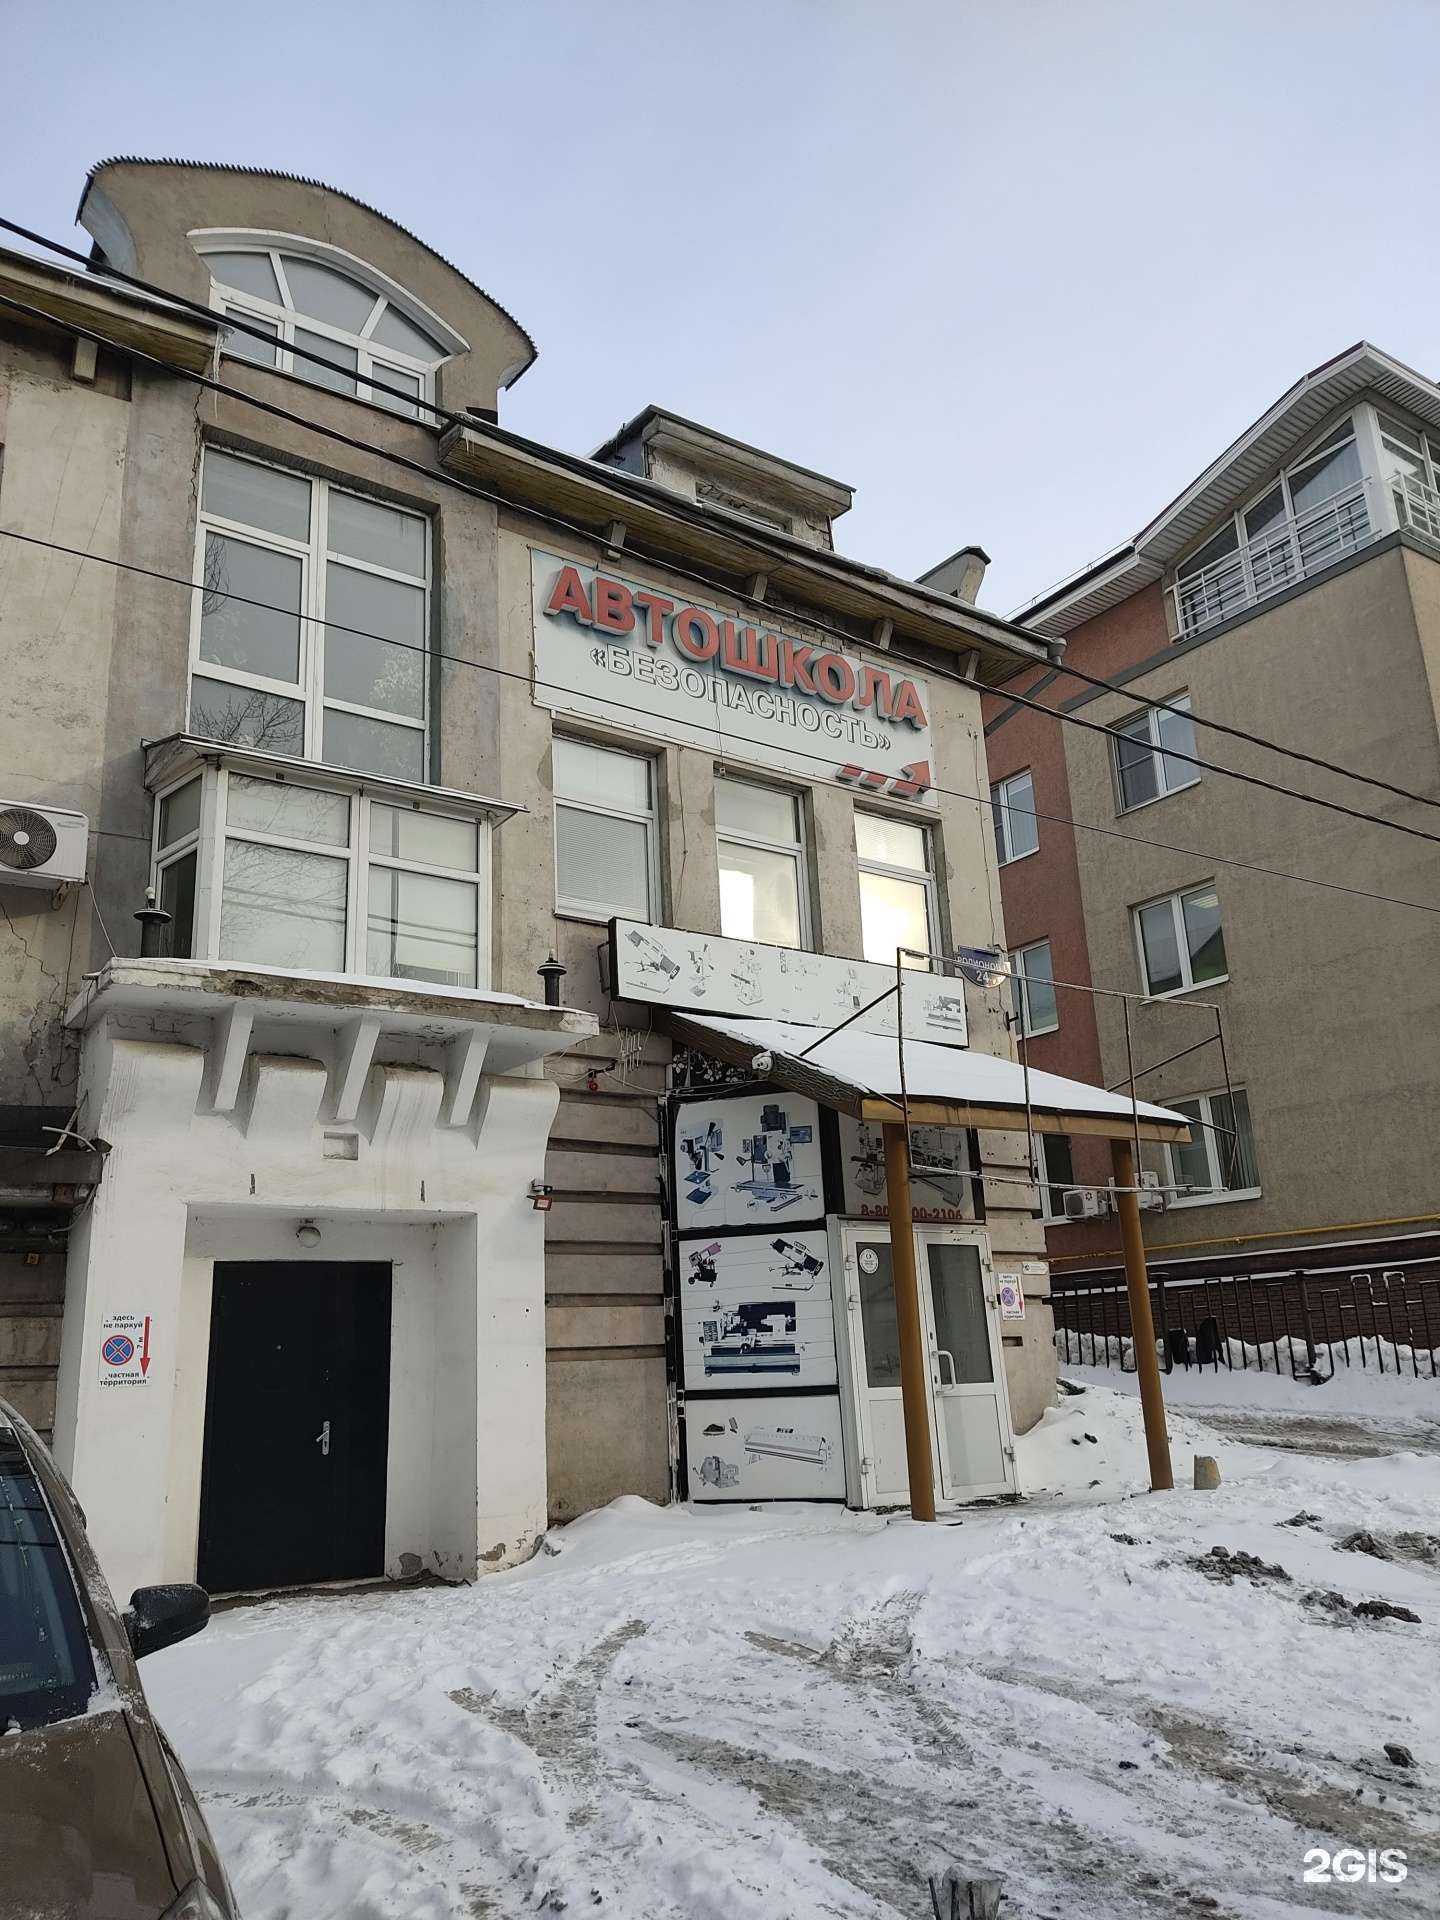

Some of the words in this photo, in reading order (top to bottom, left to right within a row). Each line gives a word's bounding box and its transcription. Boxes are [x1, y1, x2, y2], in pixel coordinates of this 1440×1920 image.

[542, 565, 928, 730] АВТОШКОЛА
[589, 644, 891, 751] «БЕЗОПАСНОСТЬ»
[976, 970, 990, 983] 24
[114, 1321, 143, 1330] паркуй
[100, 1379, 147, 1387] территория
